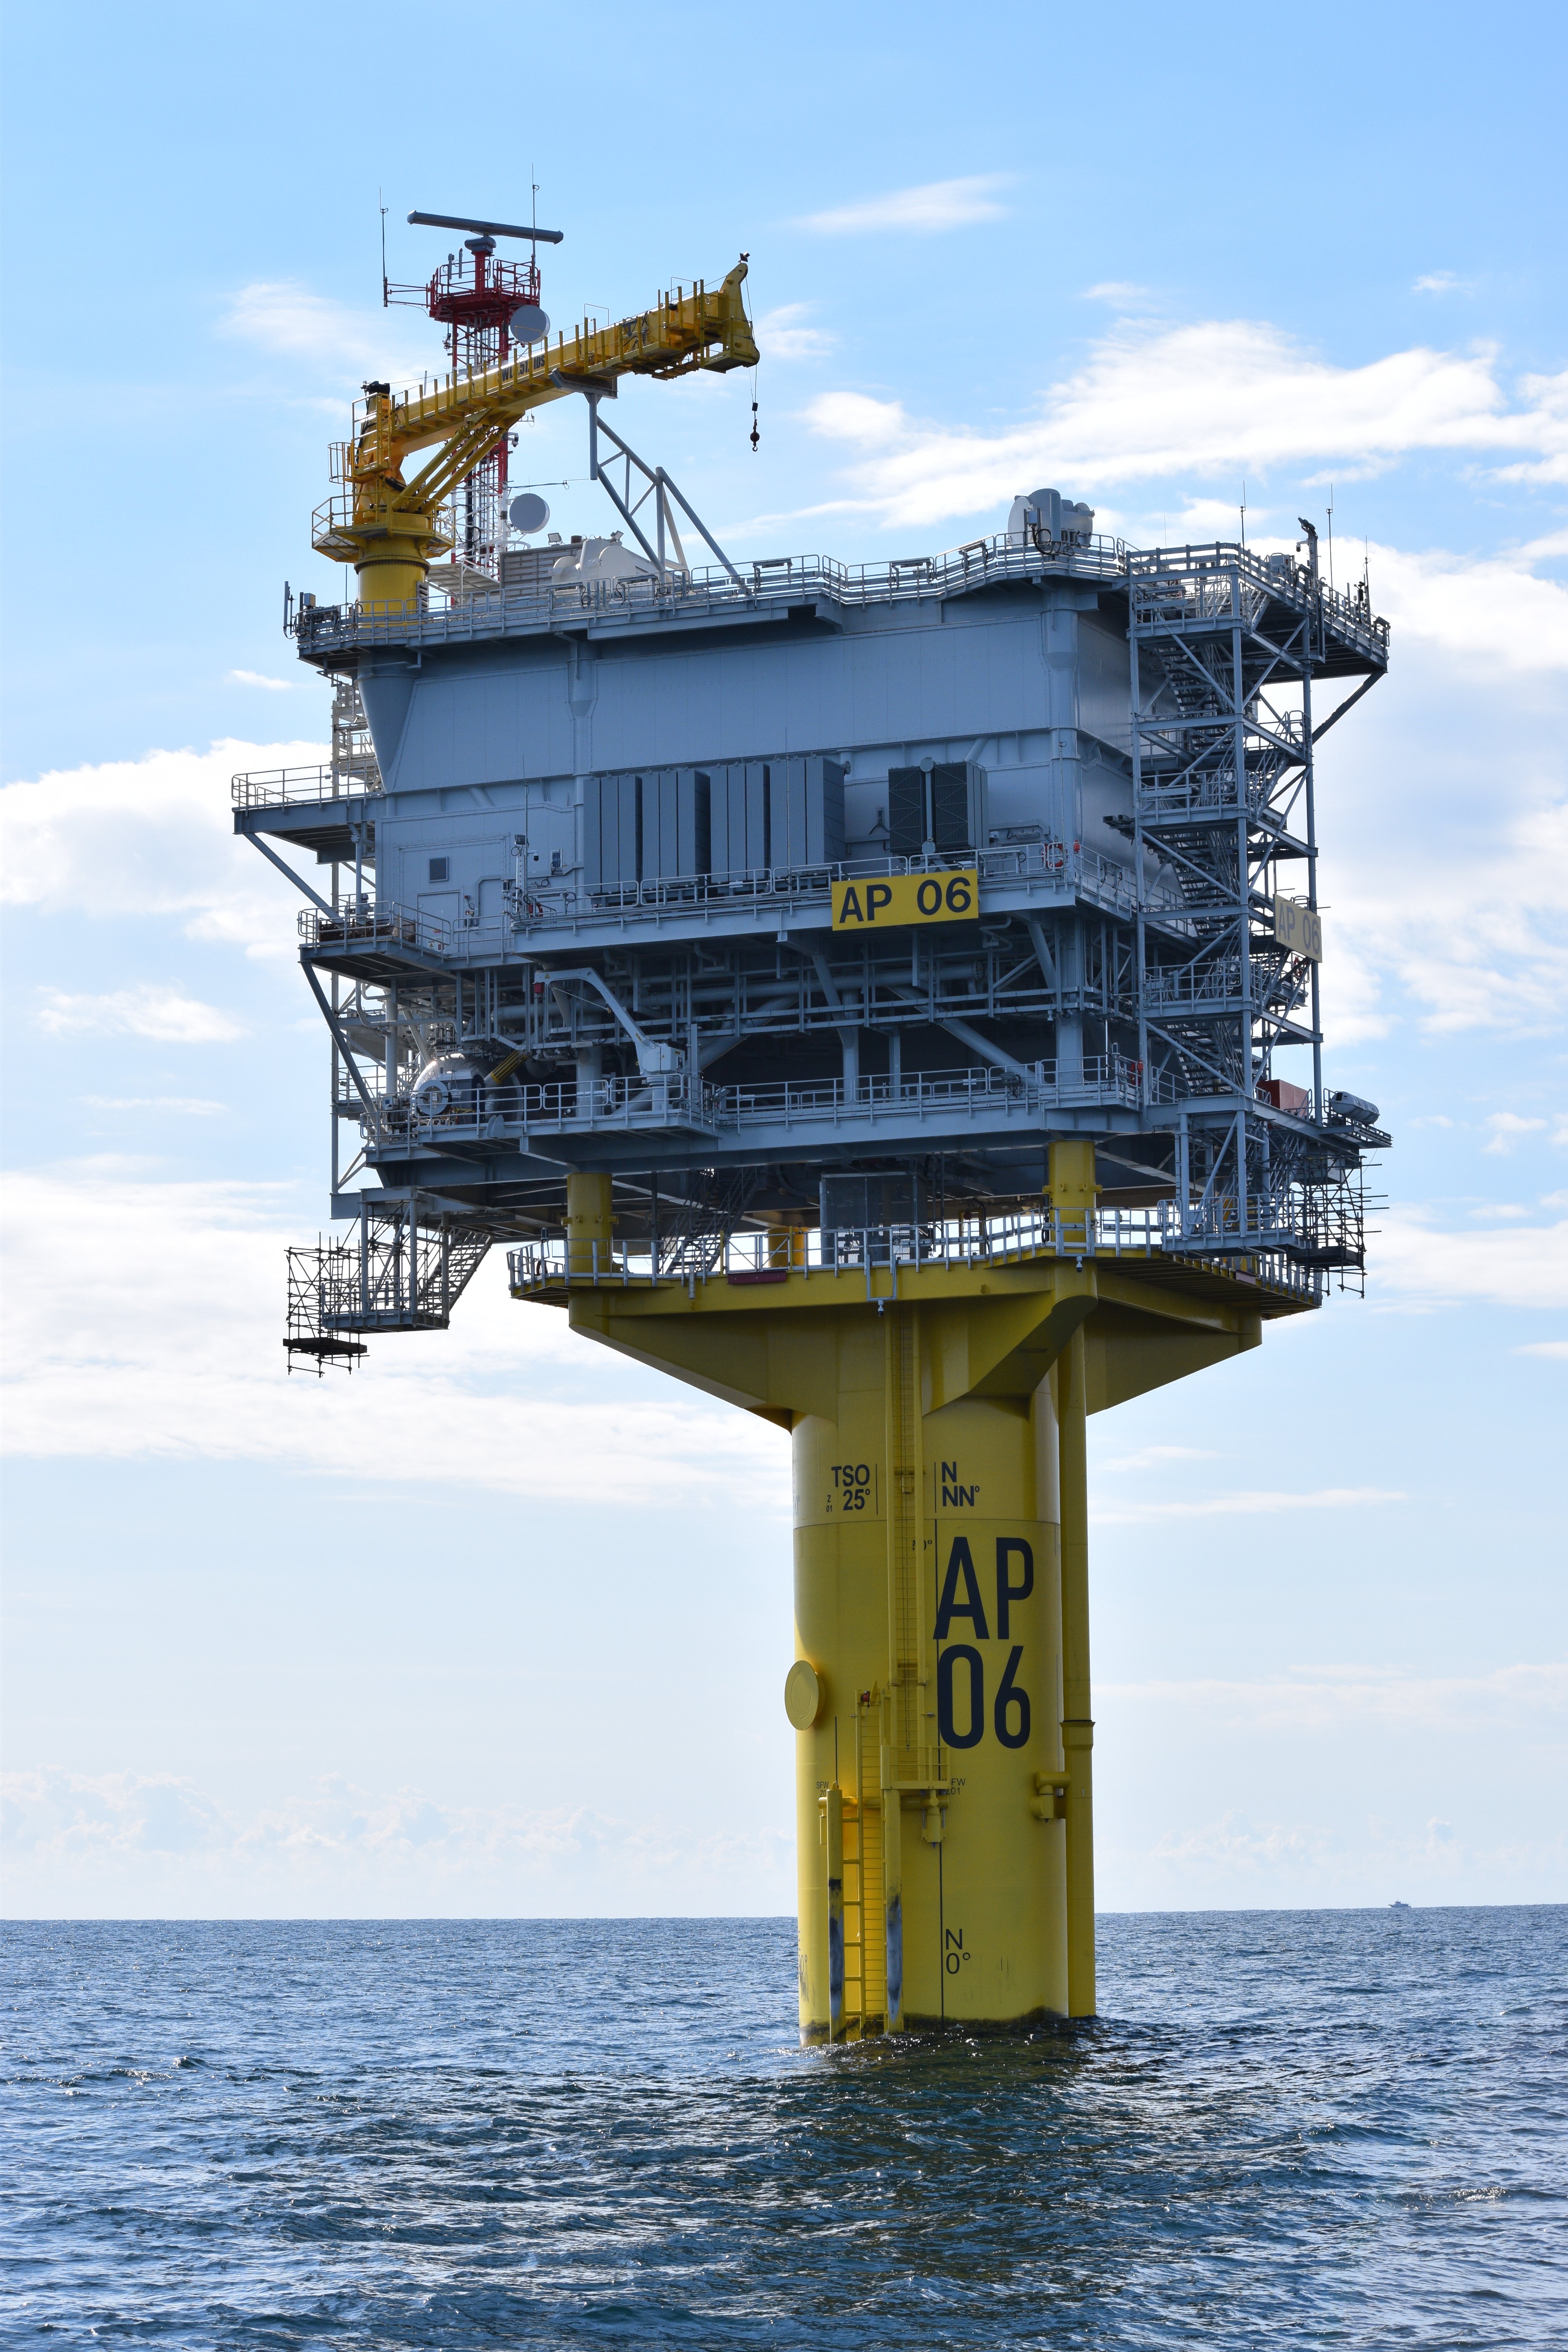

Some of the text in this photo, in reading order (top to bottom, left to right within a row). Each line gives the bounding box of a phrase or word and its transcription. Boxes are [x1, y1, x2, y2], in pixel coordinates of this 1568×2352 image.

[839, 877, 971, 923] AP 06
[1278, 903, 1320, 955] AP 06
[831, 1464, 870, 1487] TSO
[942, 1461, 956, 1483] N
[843, 1488, 870, 1510] 25°
[933, 1537, 1034, 1640] AP
[938, 1644, 1031, 1749] 06
[946, 1929, 962, 1950] N
[946, 1952, 971, 1974] 0°
